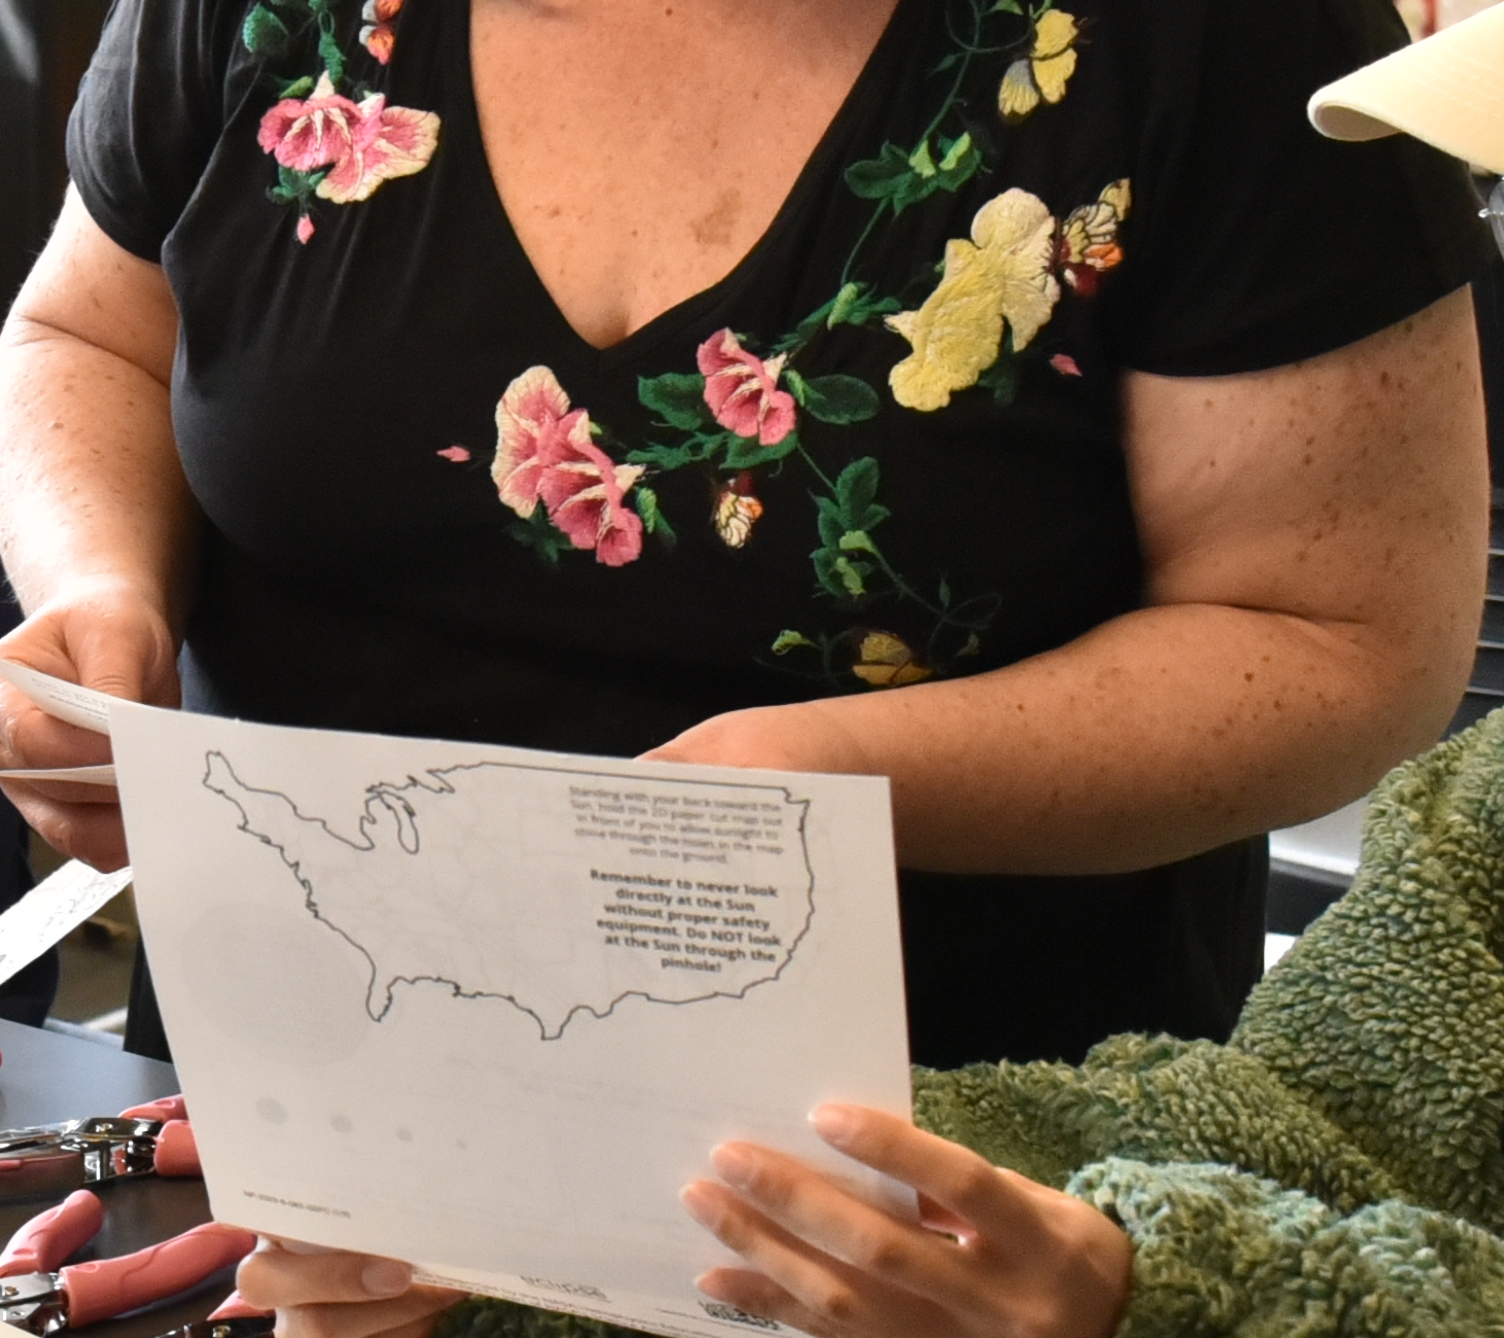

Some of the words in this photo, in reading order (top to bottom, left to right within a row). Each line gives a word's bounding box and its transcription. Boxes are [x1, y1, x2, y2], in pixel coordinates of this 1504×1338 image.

[590, 869, 671, 888] Remember
[676, 880, 693, 890] to
[697, 882, 739, 894] never
[745, 884, 778, 897] look
[616, 888, 672, 906] directly
[677, 895, 692, 906] at
[697, 896, 722, 910] the
[726, 899, 755, 912] Sun
[604, 903, 663, 919] without
[667, 910, 717, 927] proper
[722, 915, 770, 931] safety
[596, 918, 682, 938] equipment.
[686, 927, 707, 940] Do
[711, 930, 743, 942] NOT
[748, 933, 782, 947] look
[605, 934, 619, 945] at
[624, 935, 649, 949] the
[653, 940, 680, 952] Sun
[685, 944, 746, 962] through
[750, 949, 776, 962] the
[661, 956, 722, 973] pinhole!
